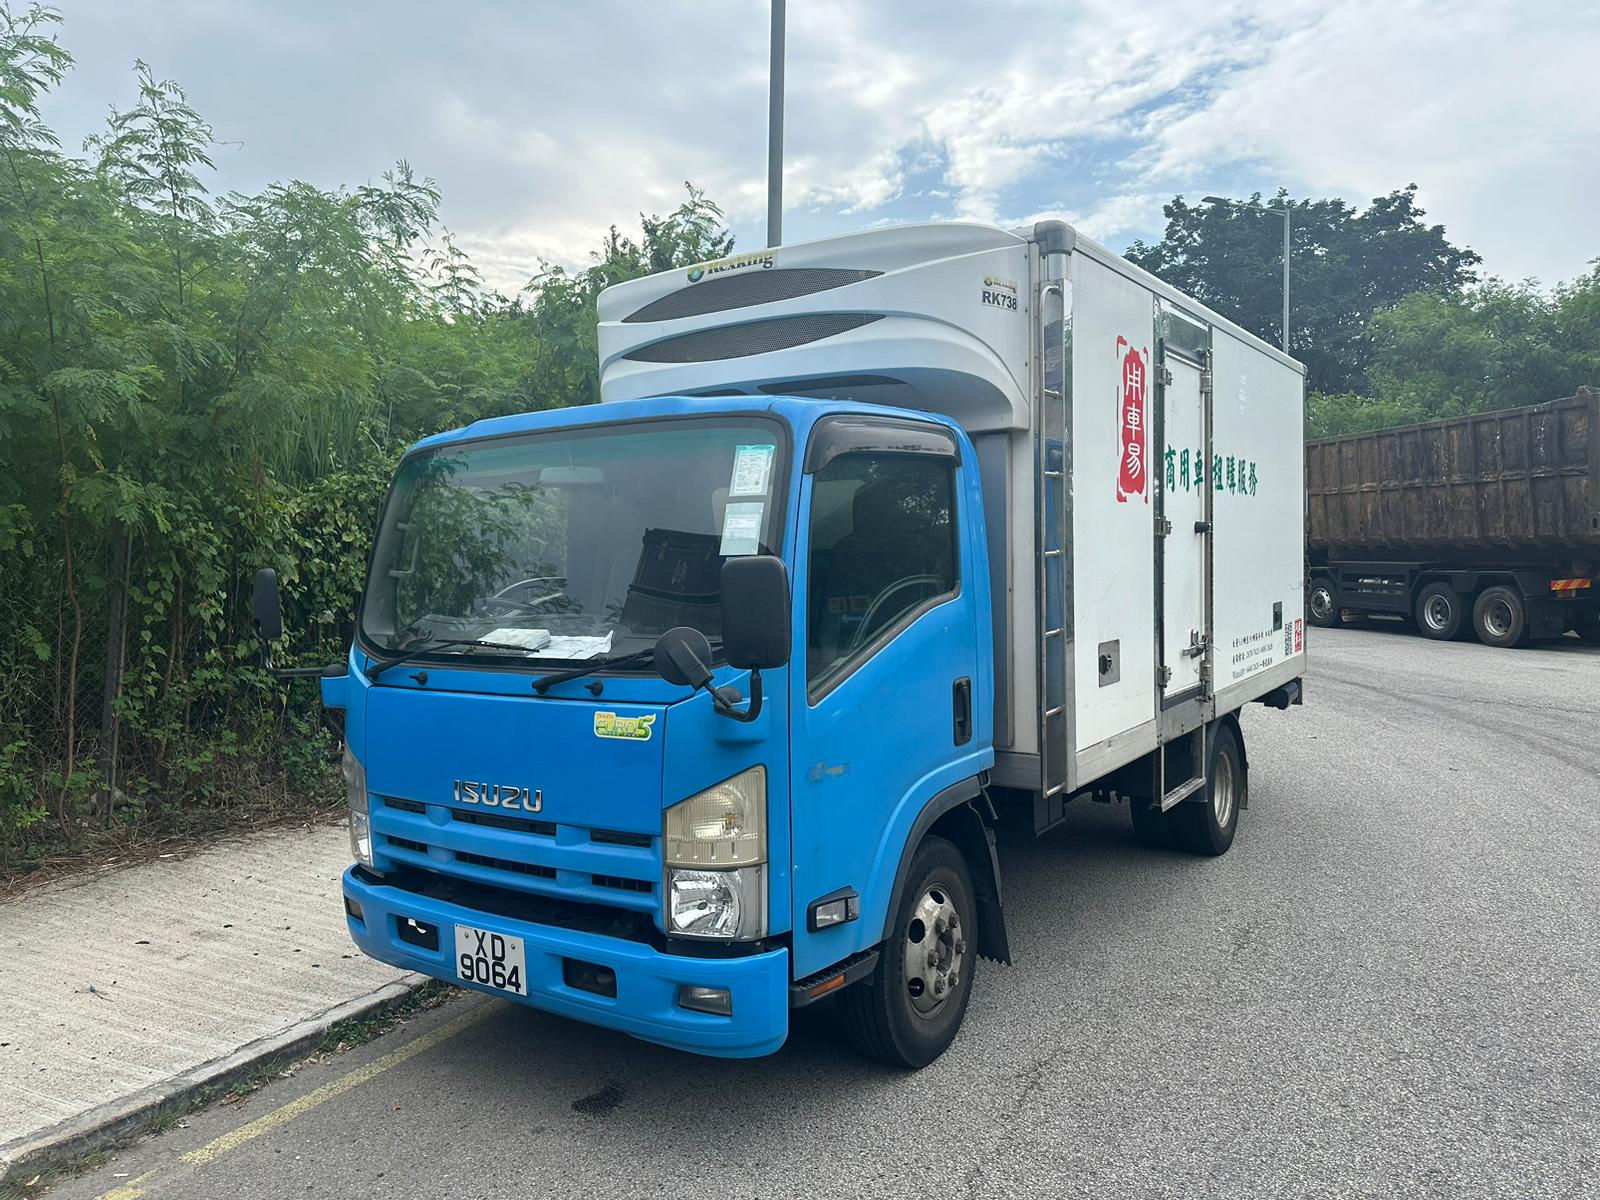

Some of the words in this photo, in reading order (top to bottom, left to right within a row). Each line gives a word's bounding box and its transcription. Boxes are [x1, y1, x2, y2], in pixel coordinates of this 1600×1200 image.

[982, 290, 1017, 310] RK738
[453, 779, 543, 813] ISUZU
[474, 929, 506, 962] XD
[460, 953, 522, 993] 9064
